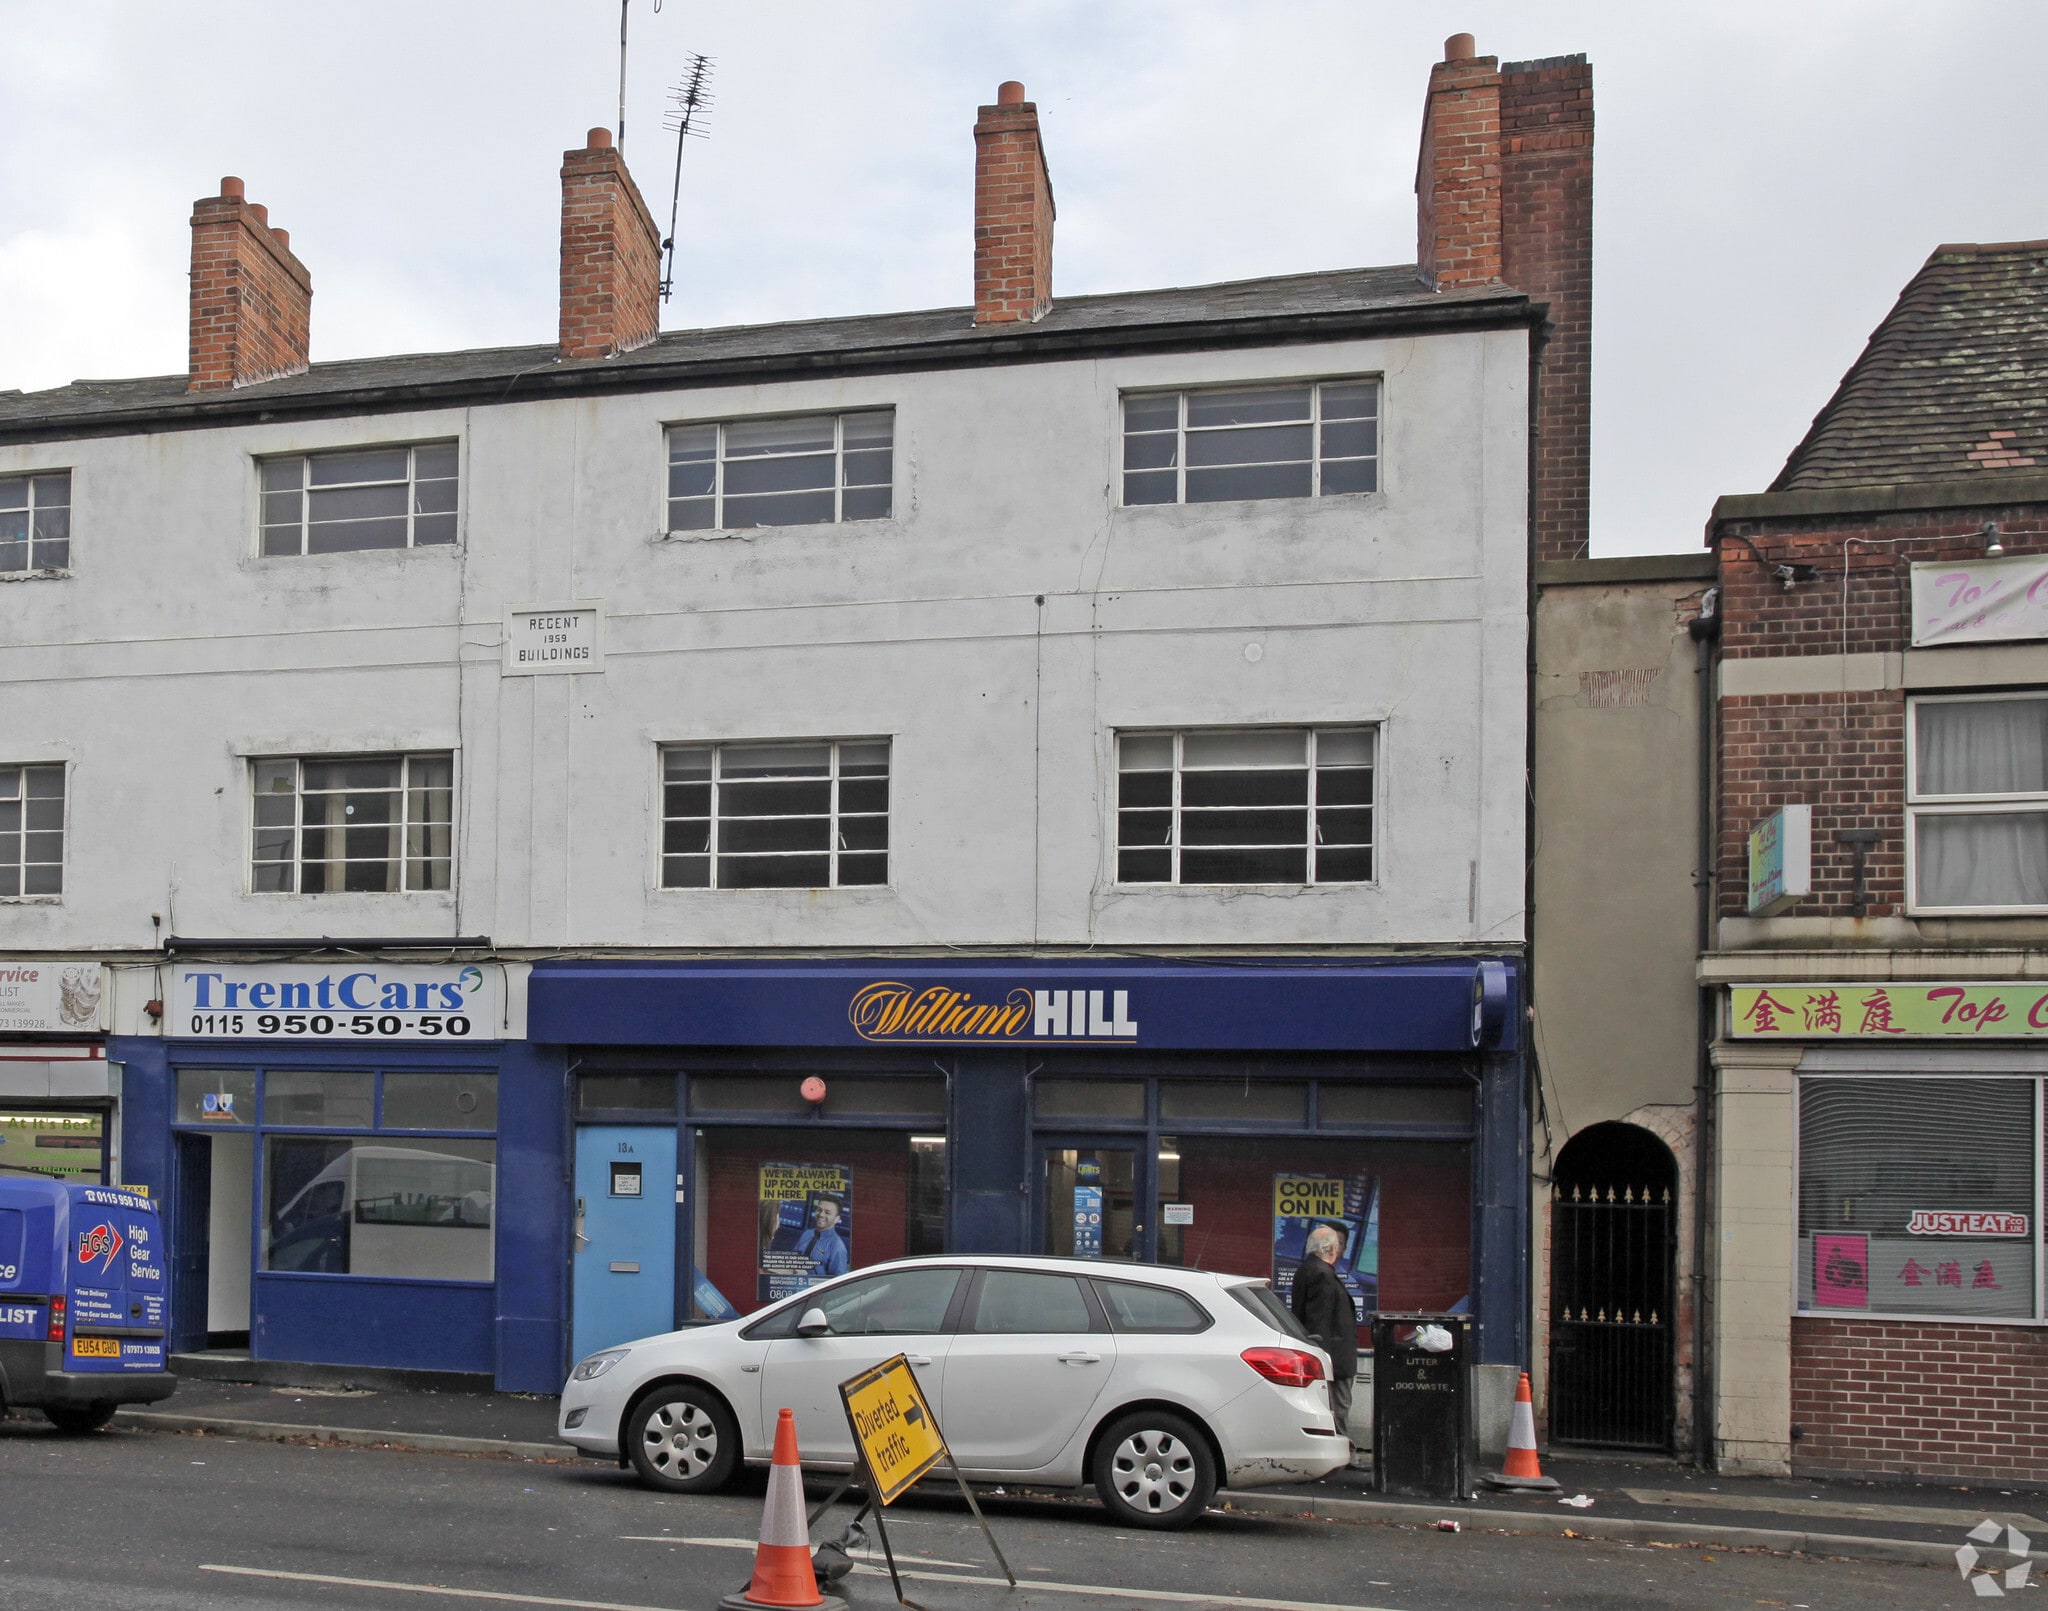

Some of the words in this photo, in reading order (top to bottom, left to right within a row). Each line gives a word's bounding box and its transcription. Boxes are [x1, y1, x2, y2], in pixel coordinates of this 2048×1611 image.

[529, 616, 579, 630] REGENT
[544, 634, 567, 643] 1959
[519, 647, 589, 661] BUILDINGS
[0, 966, 39, 983] rvice
[848, 981, 1034, 1041] William
[1034, 990, 1138, 1036] HILL
[1927, 986, 2010, 1032] Top
[191, 1014, 243, 1035] 0115
[257, 1015, 471, 1036] 950-50-50
[62, 1119, 97, 1131] Best
[764, 1169, 794, 1179] WE'RE
[796, 1170, 836, 1179] ALWAYS
[764, 1179, 778, 1188] UP
[780, 1180, 800, 1189] FOR
[802, 1180, 810, 1189] A
[812, 1180, 841, 1190] CHAT
[1279, 1181, 1340, 1198] COME
[764, 1190, 775, 1198] IN
[777, 1190, 804, 1199] HERE.
[1279, 1199, 1310, 1215] ON
[1316, 1200, 1341, 1216] IN.
[1911, 1213, 1964, 1231] JUST
[1968, 1214, 2010, 1232] EAT
[129, 1224, 148, 1244] High
[80, 1231, 111, 1255] HGS
[131, 1245, 150, 1261] Gear
[131, 1262, 160, 1280] Service
[1406, 1357, 1439, 1366] LITTER
[1417, 1368, 1427, 1380] &
[1395, 1382, 1415, 1390] DOG
[1416, 1383, 1449, 1391] WASTE
[854, 1391, 901, 1440] Diverted
[874, 1432, 910, 1472] traffic
